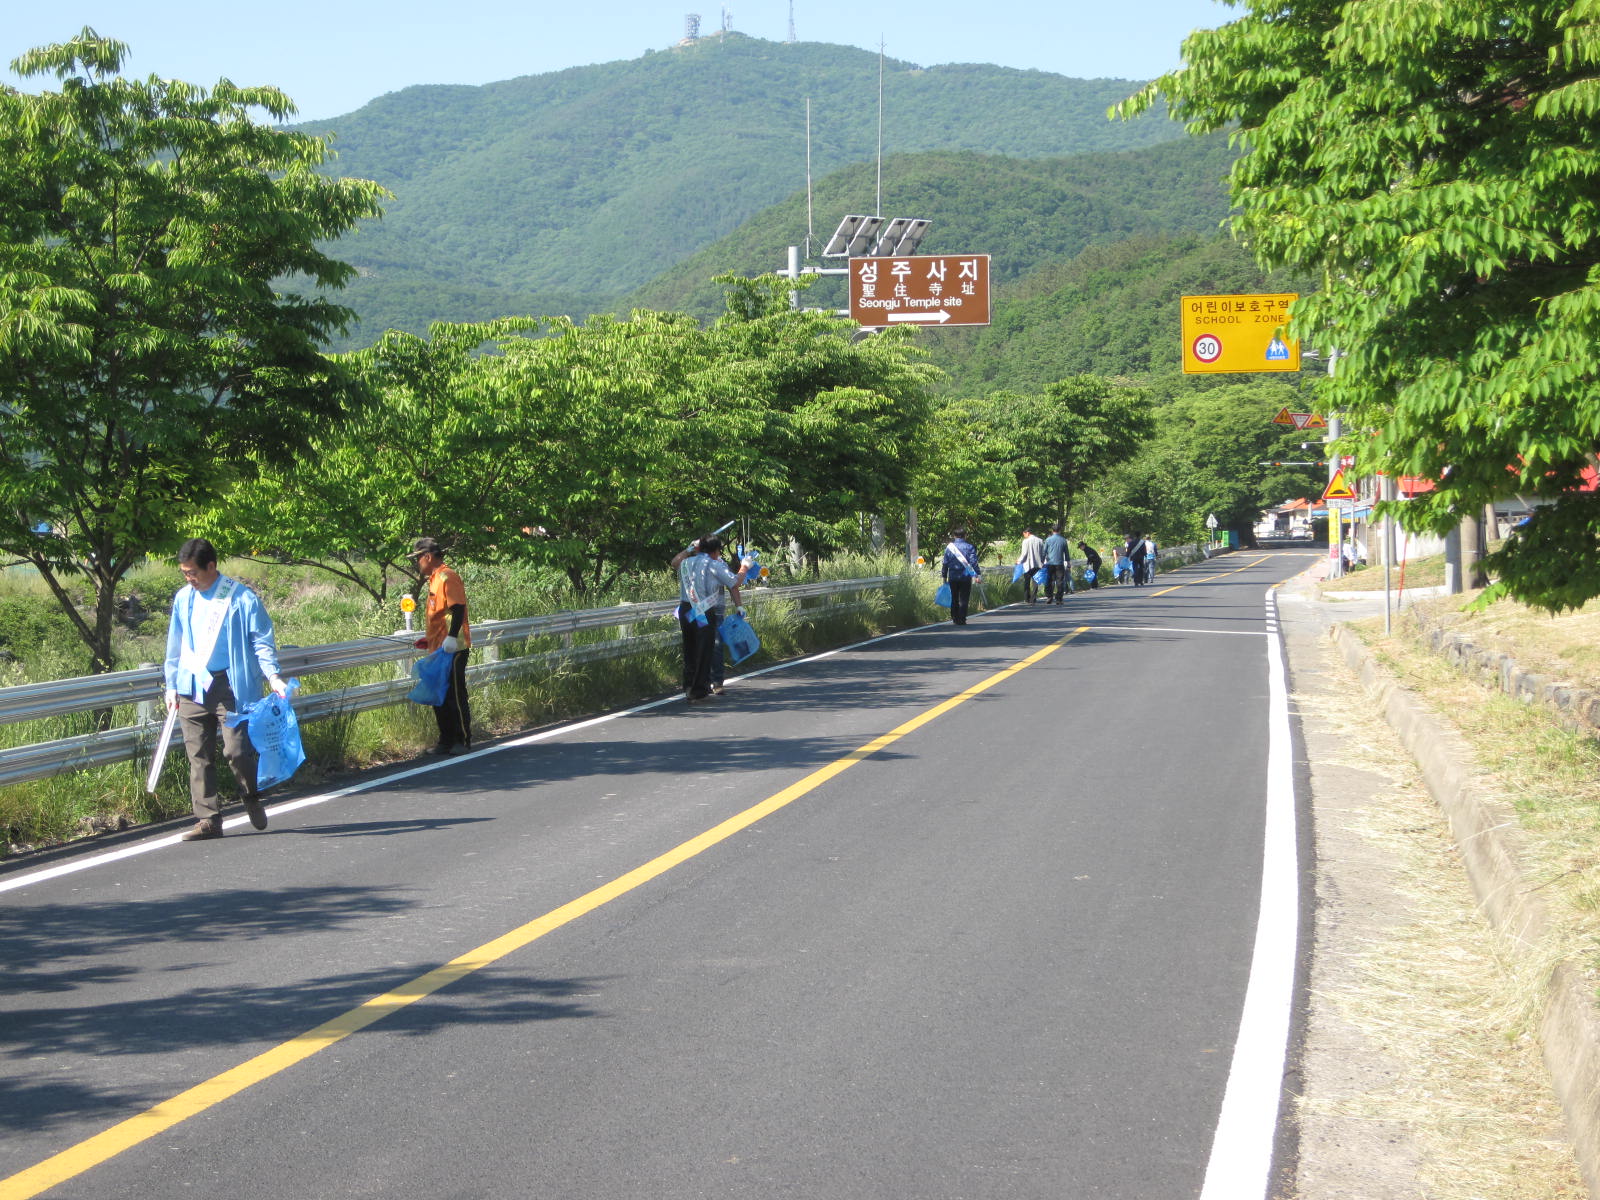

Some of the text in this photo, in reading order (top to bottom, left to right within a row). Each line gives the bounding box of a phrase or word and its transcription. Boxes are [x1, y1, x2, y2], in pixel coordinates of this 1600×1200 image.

[859, 295, 963, 310] Seongju Temple site
[1191, 299, 1290, 314] 어린이보호구역
[1195, 314, 1285, 325] SCHOOL ZONE
[1198, 342, 1216, 355] 30
